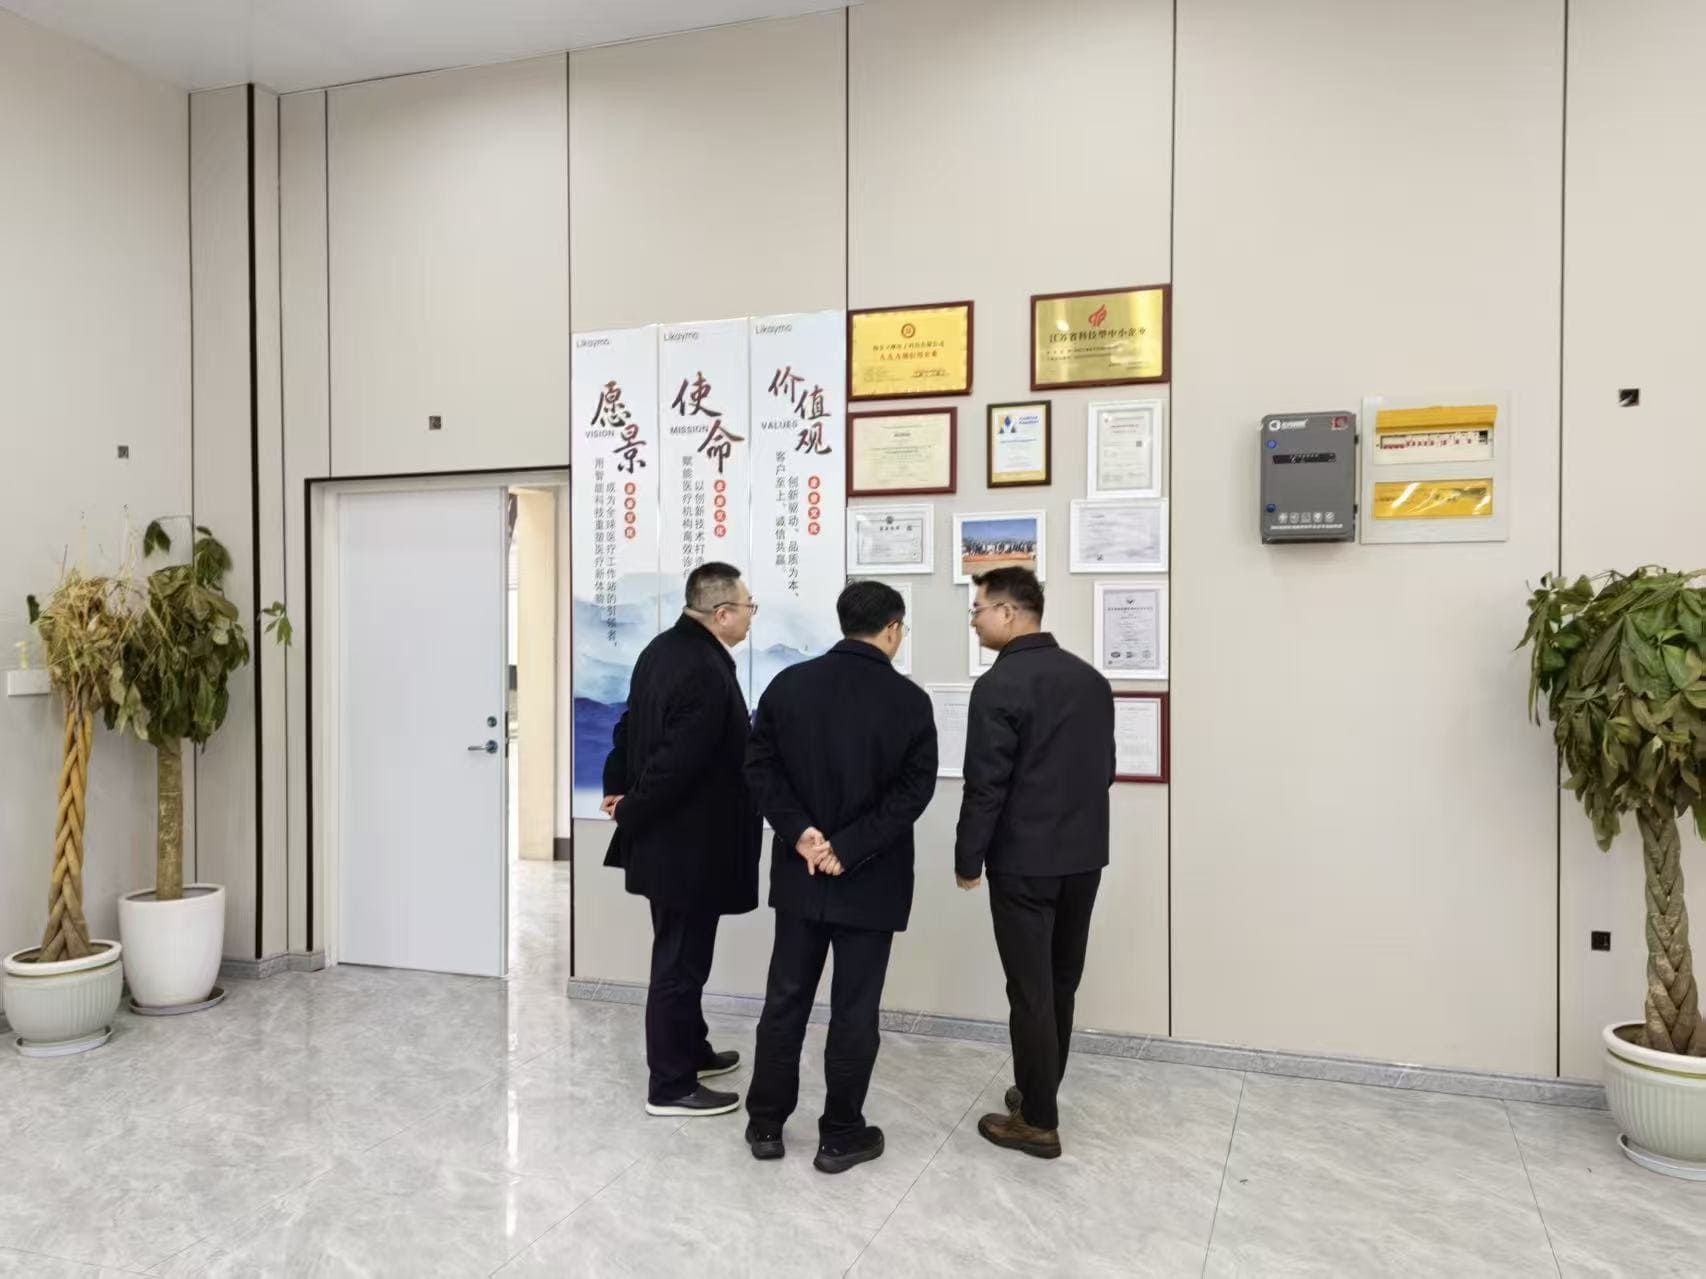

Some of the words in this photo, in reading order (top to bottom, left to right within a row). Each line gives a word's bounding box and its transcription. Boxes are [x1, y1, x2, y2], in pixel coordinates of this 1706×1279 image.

[585, 429, 616, 439] VISION
[591, 380, 647, 475] 愿景
[670, 424, 709, 435] MISSION
[672, 371, 745, 474] 使命
[761, 419, 798, 431] VALUES
[768, 365, 833, 455] 价值观
